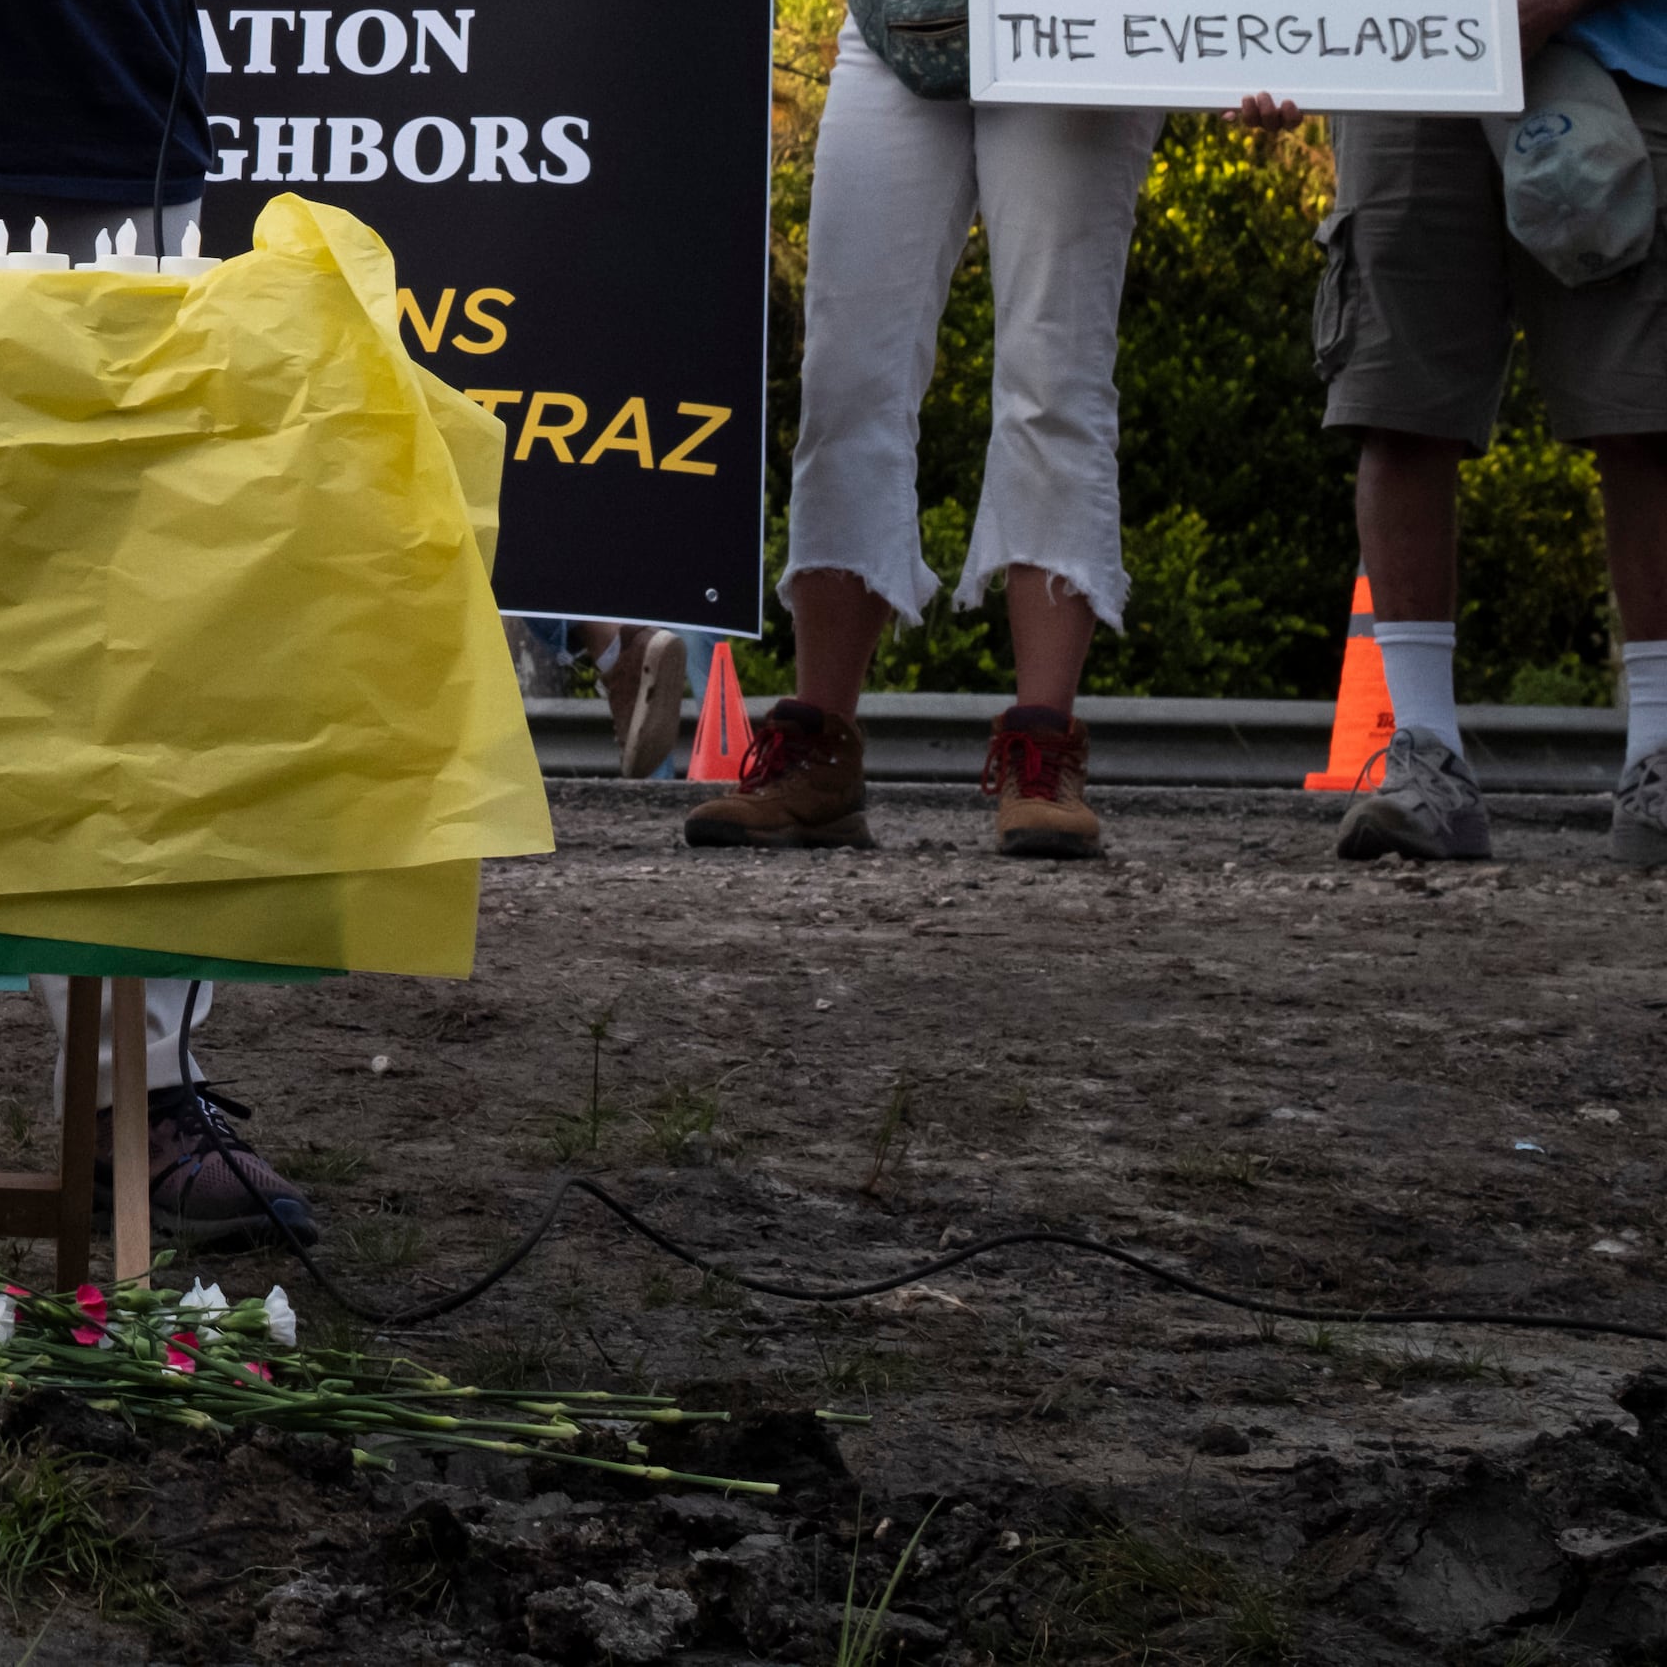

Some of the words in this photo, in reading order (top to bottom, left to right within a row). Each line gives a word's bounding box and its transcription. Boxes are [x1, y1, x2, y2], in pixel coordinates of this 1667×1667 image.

[999, 12, 1096, 63] THE
[1124, 13, 1486, 63] EVERGLADES
[204, 115, 592, 185] GHBORS
[396, 287, 515, 355] NS
